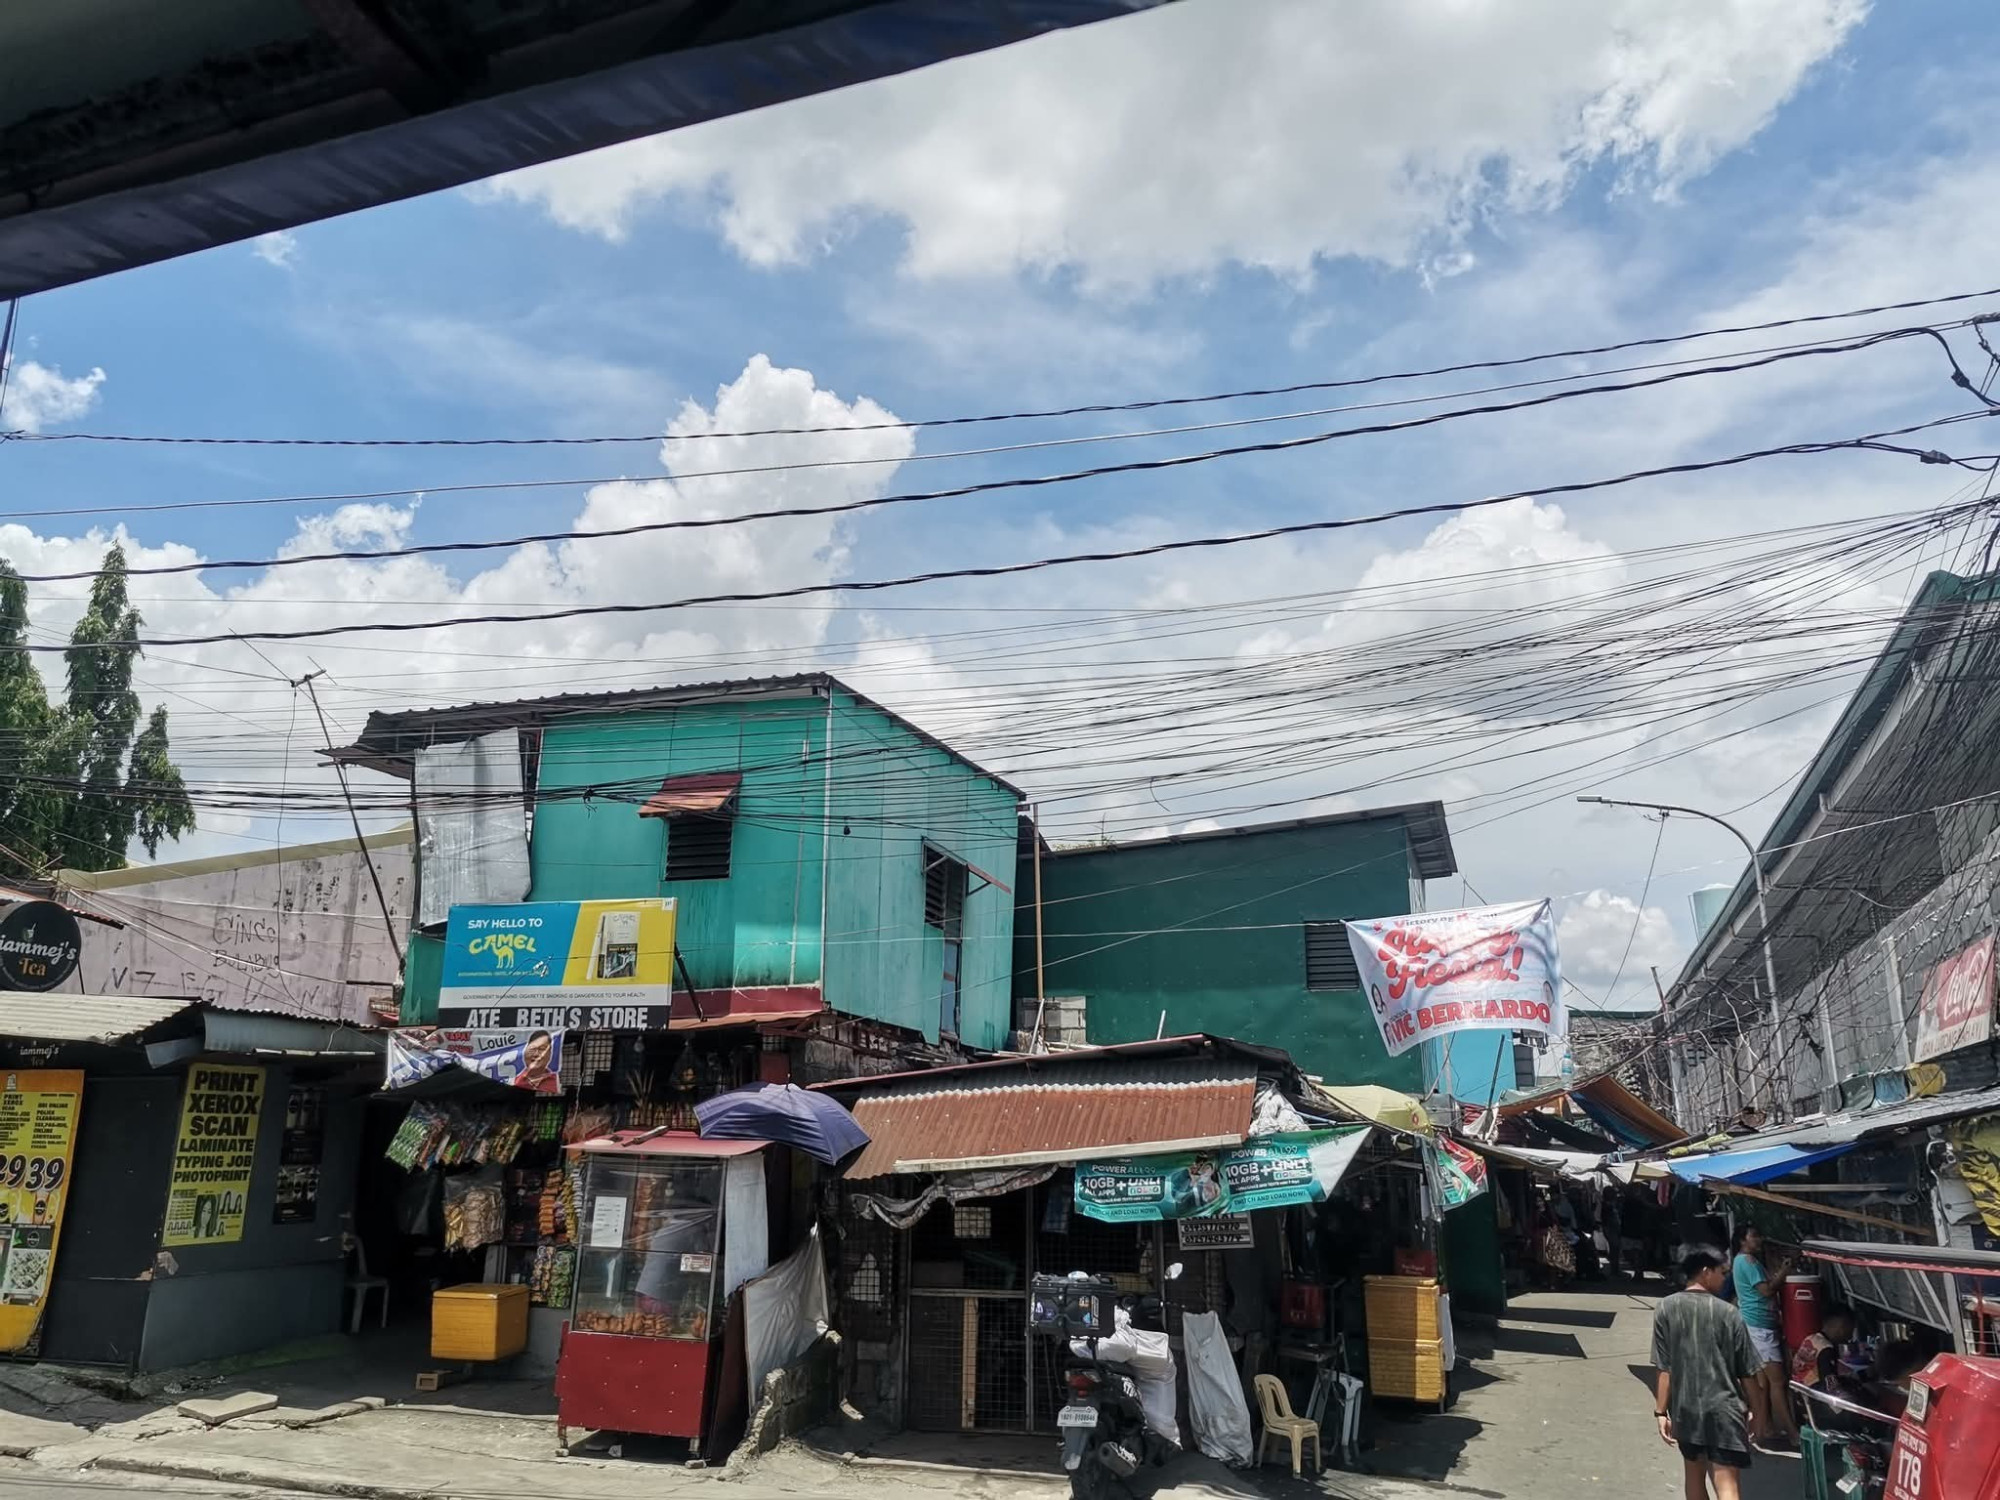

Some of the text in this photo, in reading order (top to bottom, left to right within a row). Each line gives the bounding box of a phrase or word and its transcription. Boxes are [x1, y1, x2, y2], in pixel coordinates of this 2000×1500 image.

[468, 918, 543, 929] SAY HELLO TO
[469, 933, 536, 954] CAMEL
[19, 957, 46, 976] Tea
[466, 1006, 648, 1029] ATE BETH'S STORE
[1391, 1013, 1415, 1042] VIC
[1417, 999, 1551, 1029] BERNARDO
[477, 1032, 517, 1052] Louie
[194, 1070, 259, 1093] PRINT
[187, 1093, 260, 1115] XEROX
[190, 1115, 249, 1137] SCAN
[179, 1138, 254, 1153] LAMINATE
[175, 1154, 252, 1169] TYPING JOB
[1225, 1162, 1260, 1177] 10GB
[173, 1169, 250, 1183] PHOTOPRINT
[1084, 1177, 1116, 1190] 10GB
[1240, 1175, 1260, 1184] APPS
[1084, 1188, 1116, 1197] ALL APPS
[1898, 1447, 1922, 1496] 178
